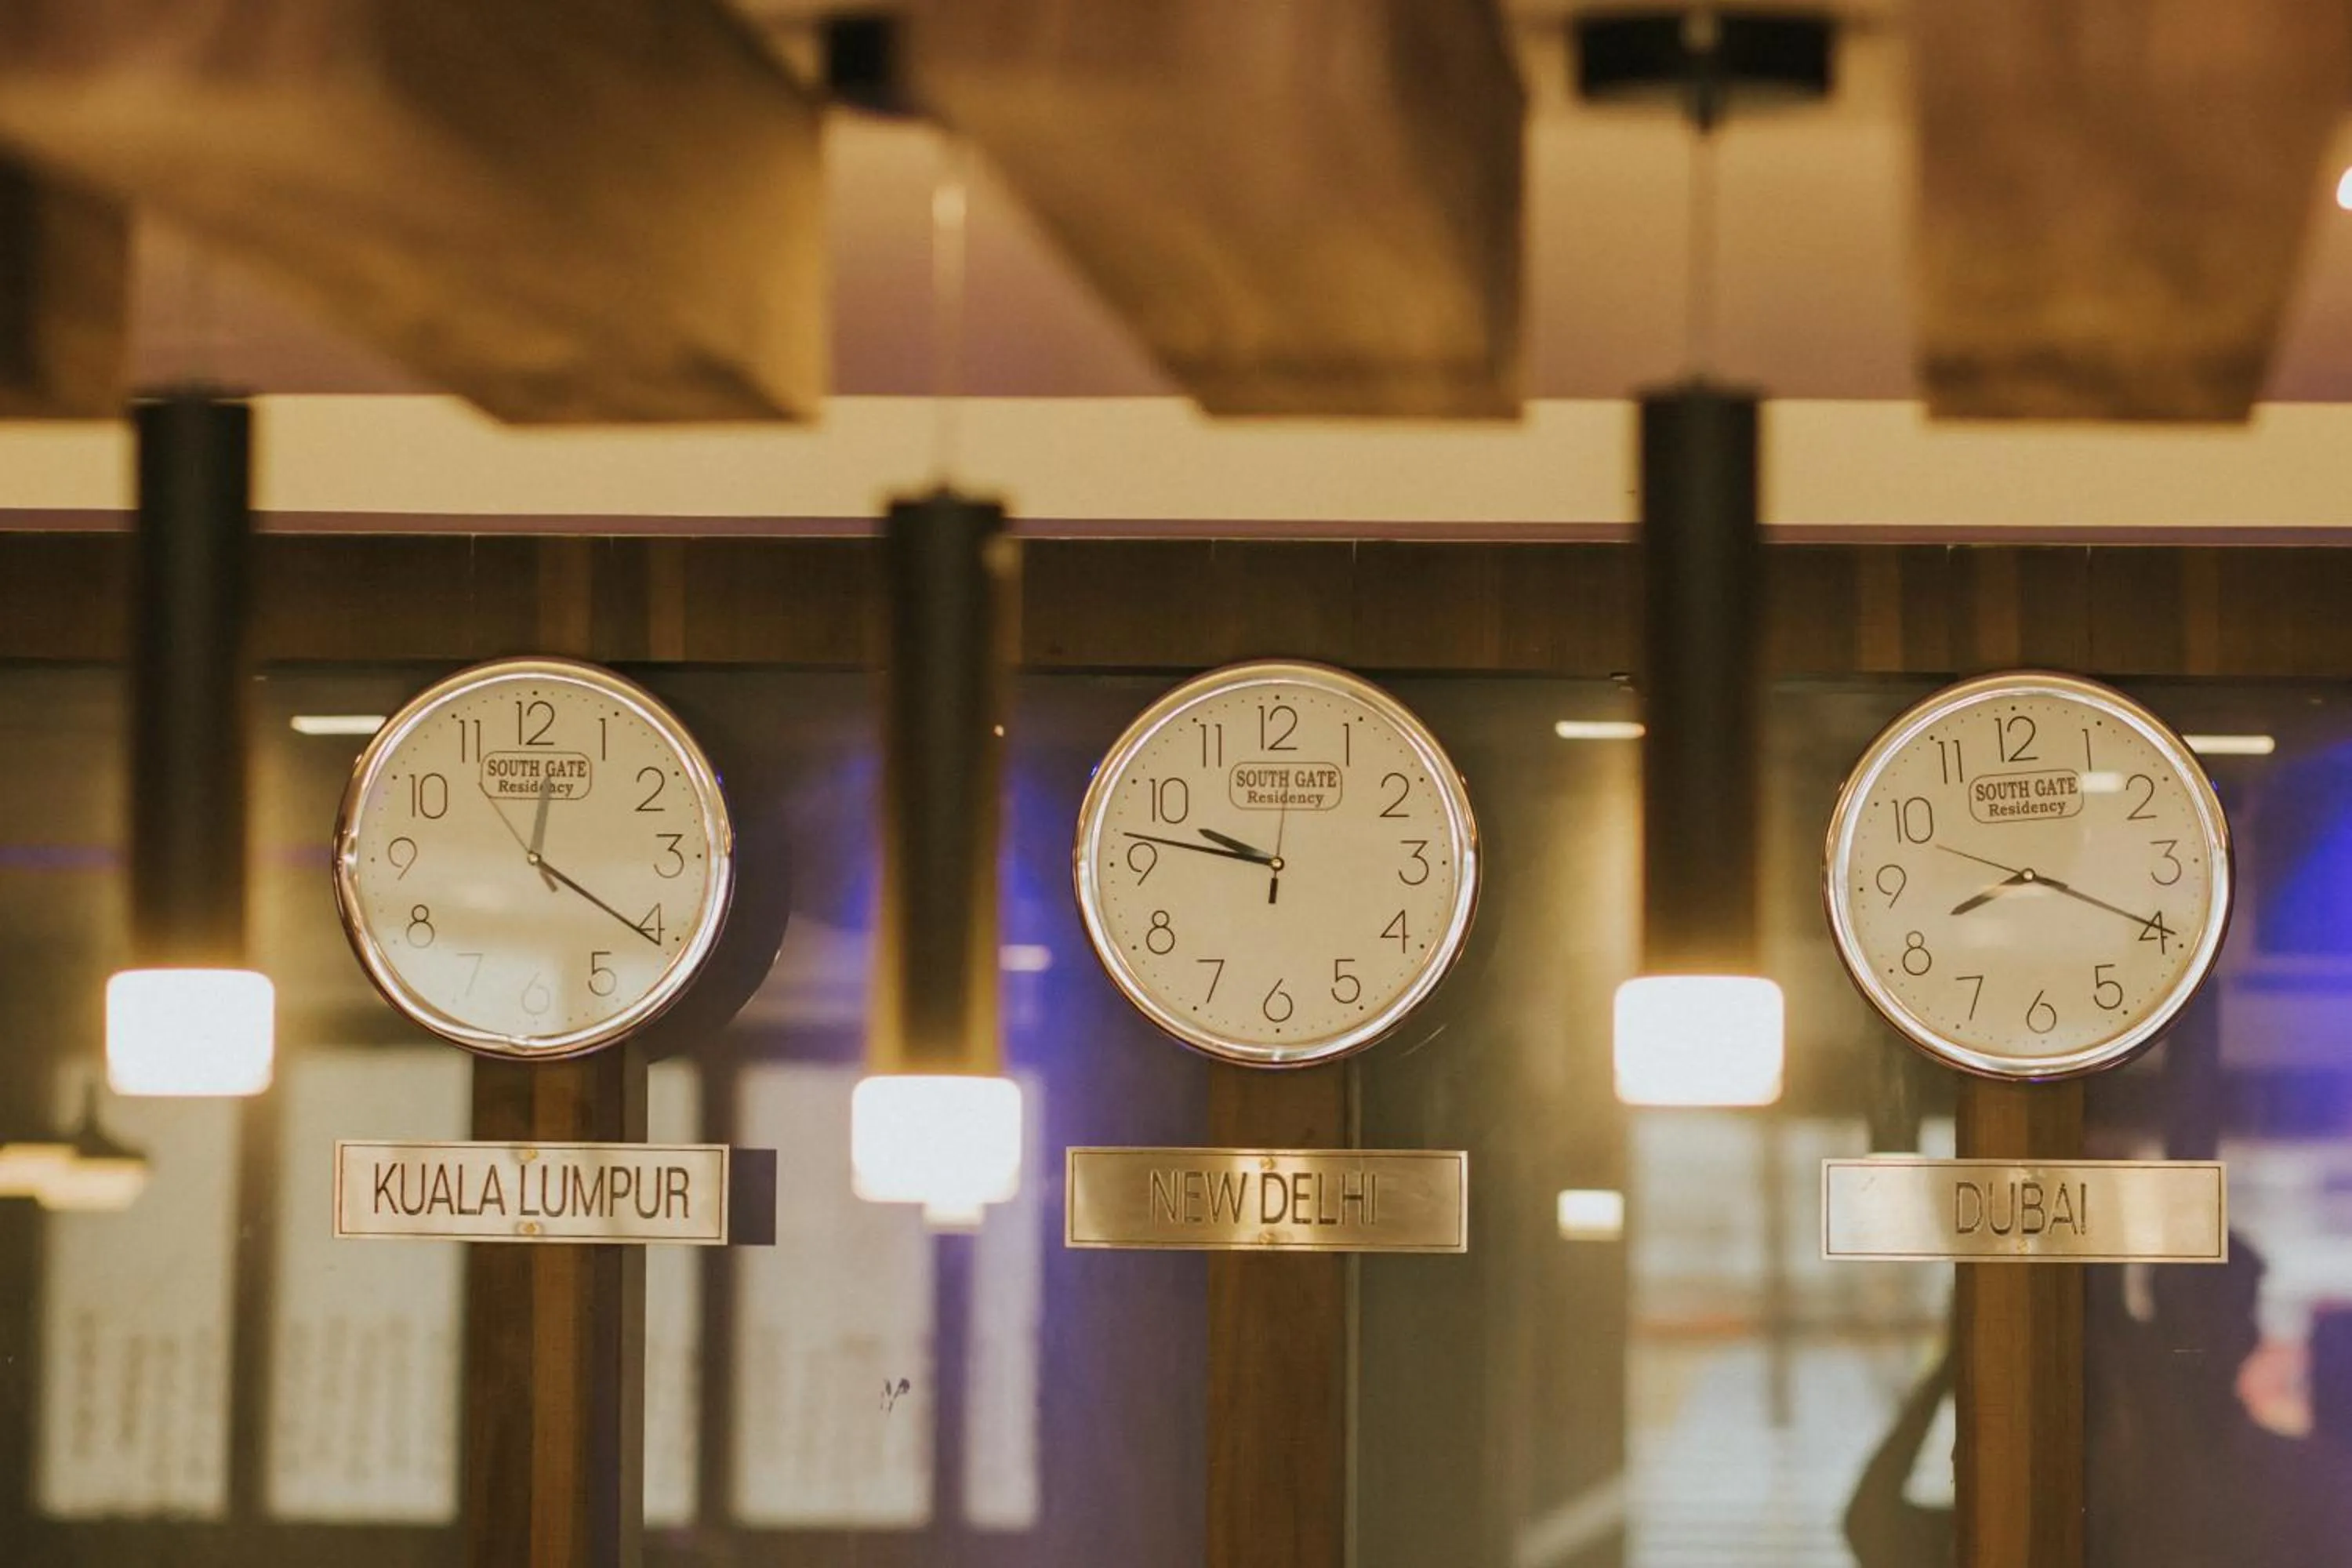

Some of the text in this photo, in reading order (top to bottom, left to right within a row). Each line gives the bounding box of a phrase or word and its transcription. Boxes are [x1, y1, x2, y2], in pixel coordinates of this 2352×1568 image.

[459, 719, 481, 763] 11
[516, 701, 555, 746] 12
[599, 717, 606, 760] 1
[1258, 706, 1298, 750] 12
[1343, 723, 1350, 767] 1
[1995, 717, 2038, 763] 12
[1200, 724, 1222, 768] 11
[1938, 740, 1963, 784] 11
[2082, 729, 2092, 772] 1
[487, 759, 586, 778] SOUTH GATE
[636, 767, 666, 811] 2
[1236, 770, 1337, 788] SOUTH GATE
[1976, 777, 2078, 801] SOUTH GATE
[410, 773, 448, 818] 10
[1149, 778, 1189, 823] 10
[1247, 790, 1324, 808] Residency
[1380, 773, 1410, 817] 2
[1988, 800, 2066, 817] Residency
[2125, 775, 2158, 820] 2
[1892, 797, 1934, 844] 10
[387, 837, 417, 880] 9
[653, 834, 684, 878] 3
[1127, 843, 1157, 886] 9
[1399, 840, 1429, 885] 3
[2150, 840, 2182, 885] 3
[1876, 865, 1907, 909] 9
[406, 905, 435, 948] 8
[638, 903, 666, 946] 4
[1146, 910, 1174, 954] 8
[1380, 909, 1410, 954] 4
[2139, 911, 2169, 954] 4
[457, 953, 483, 996] 7
[588, 952, 616, 996] 5
[1902, 931, 1932, 975] 8
[521, 972, 550, 1015] 6
[1197, 960, 1225, 1004] 7
[1263, 978, 1293, 1022] 6
[1331, 959, 1361, 1004] 5
[1956, 975, 1984, 1021] 7
[2093, 964, 2123, 1010] 5
[2026, 990, 2056, 1034] 6
[374, 1163, 690, 1218] KUALA LUMPUR
[1150, 1171, 1377, 1225] NEW DELHI
[1955, 1181, 2087, 1235] DUBAI
